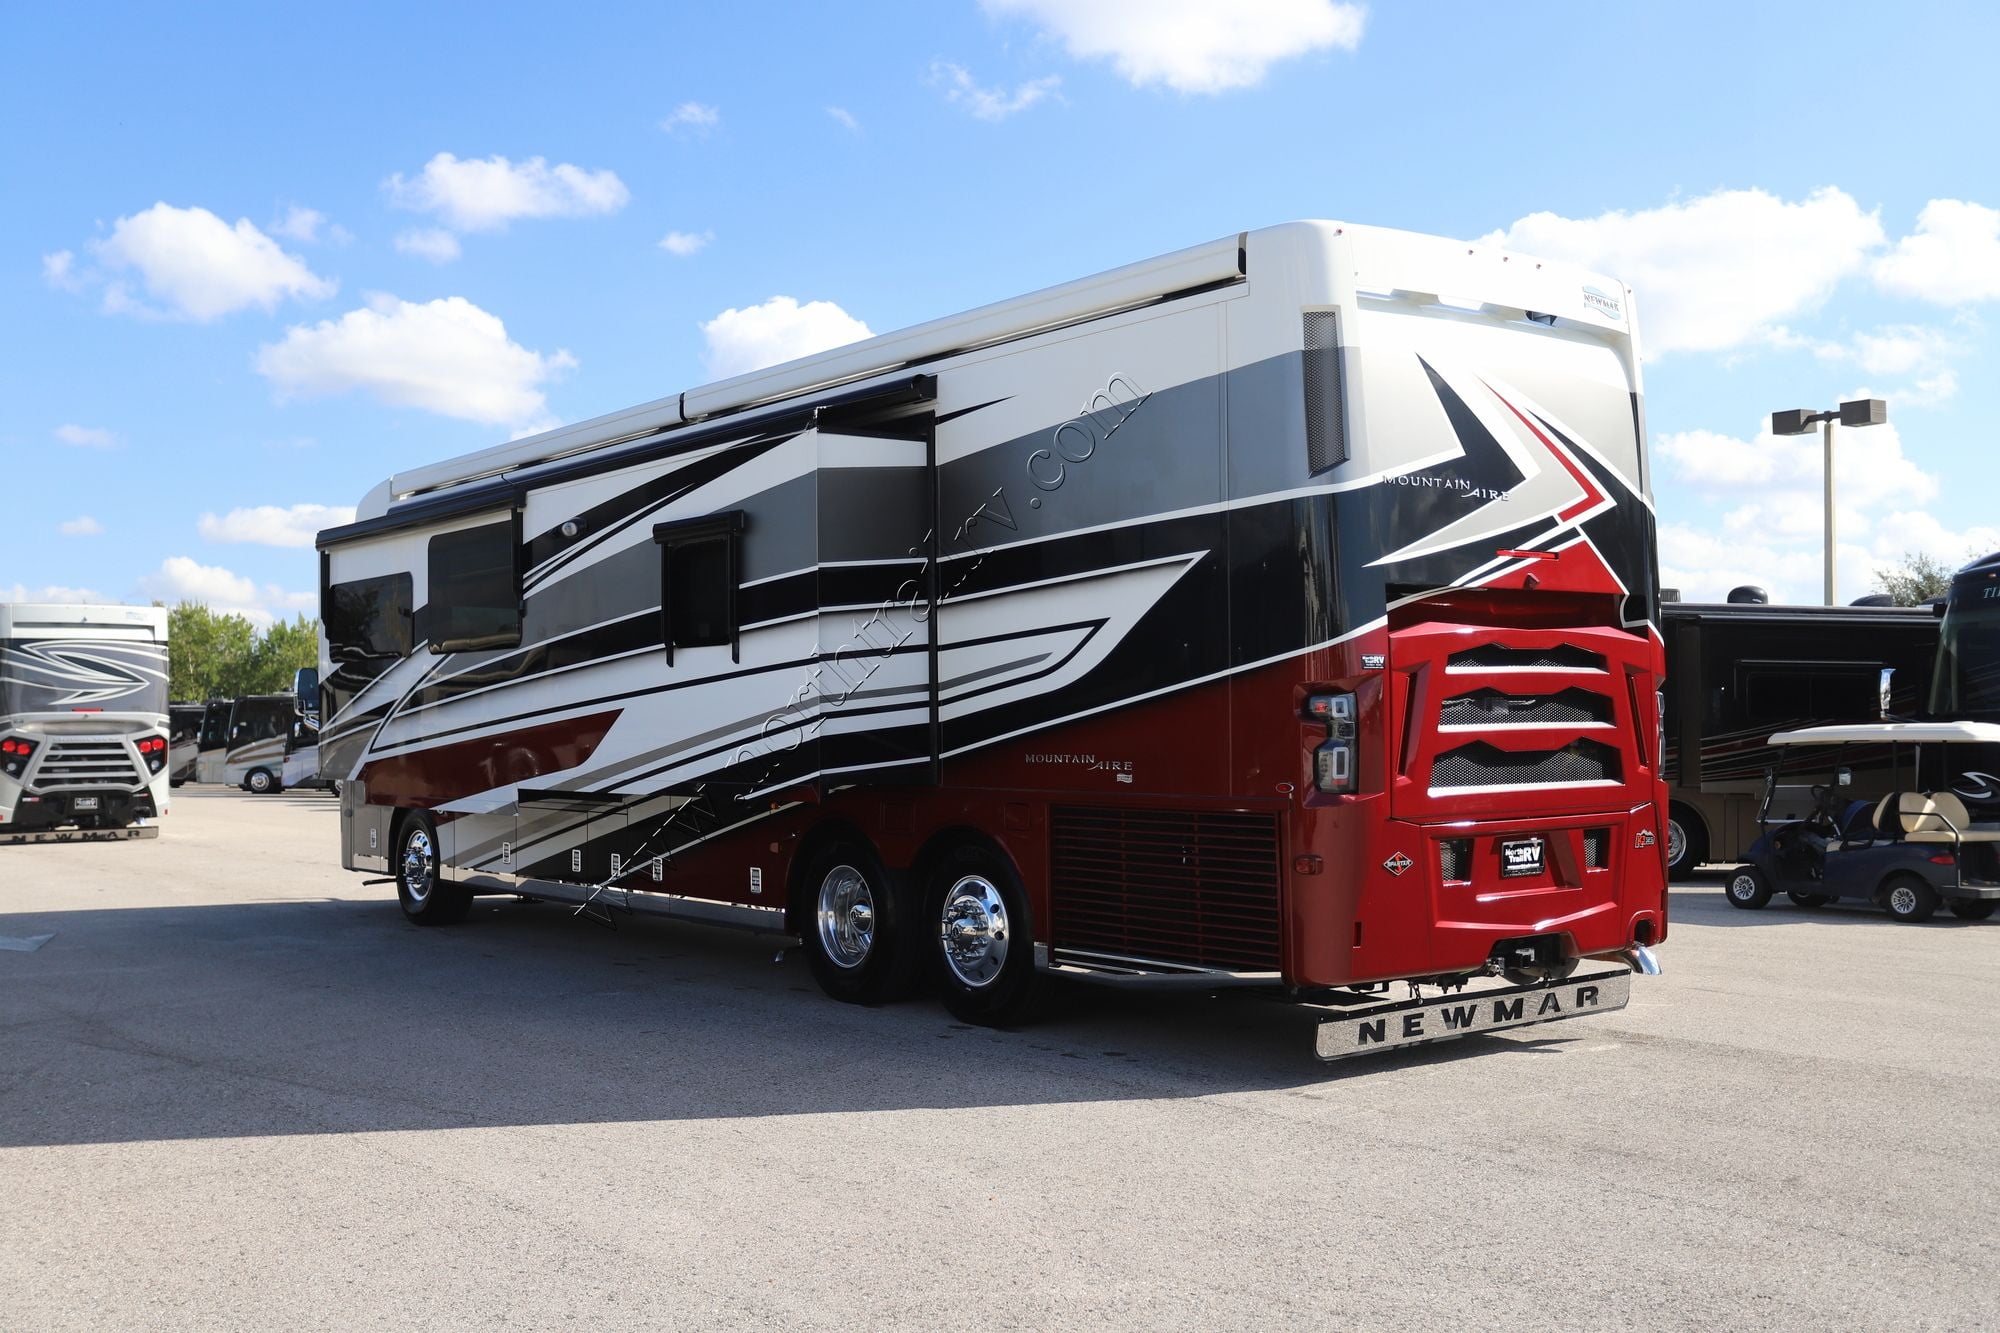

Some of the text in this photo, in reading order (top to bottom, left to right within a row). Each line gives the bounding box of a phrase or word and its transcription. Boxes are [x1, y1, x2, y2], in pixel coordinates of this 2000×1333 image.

[1583, 293, 1620, 312] NEWMAR
[1382, 475, 1511, 501] MOUNTAIN AIRE
[1025, 754, 1133, 771] MOUNTAIN AIRE
[11, 830, 141, 842] NEWMAR
[1505, 848, 1524, 856] North
[1523, 846, 1541, 862] RV
[1357, 985, 1600, 1045] NEWMAR
